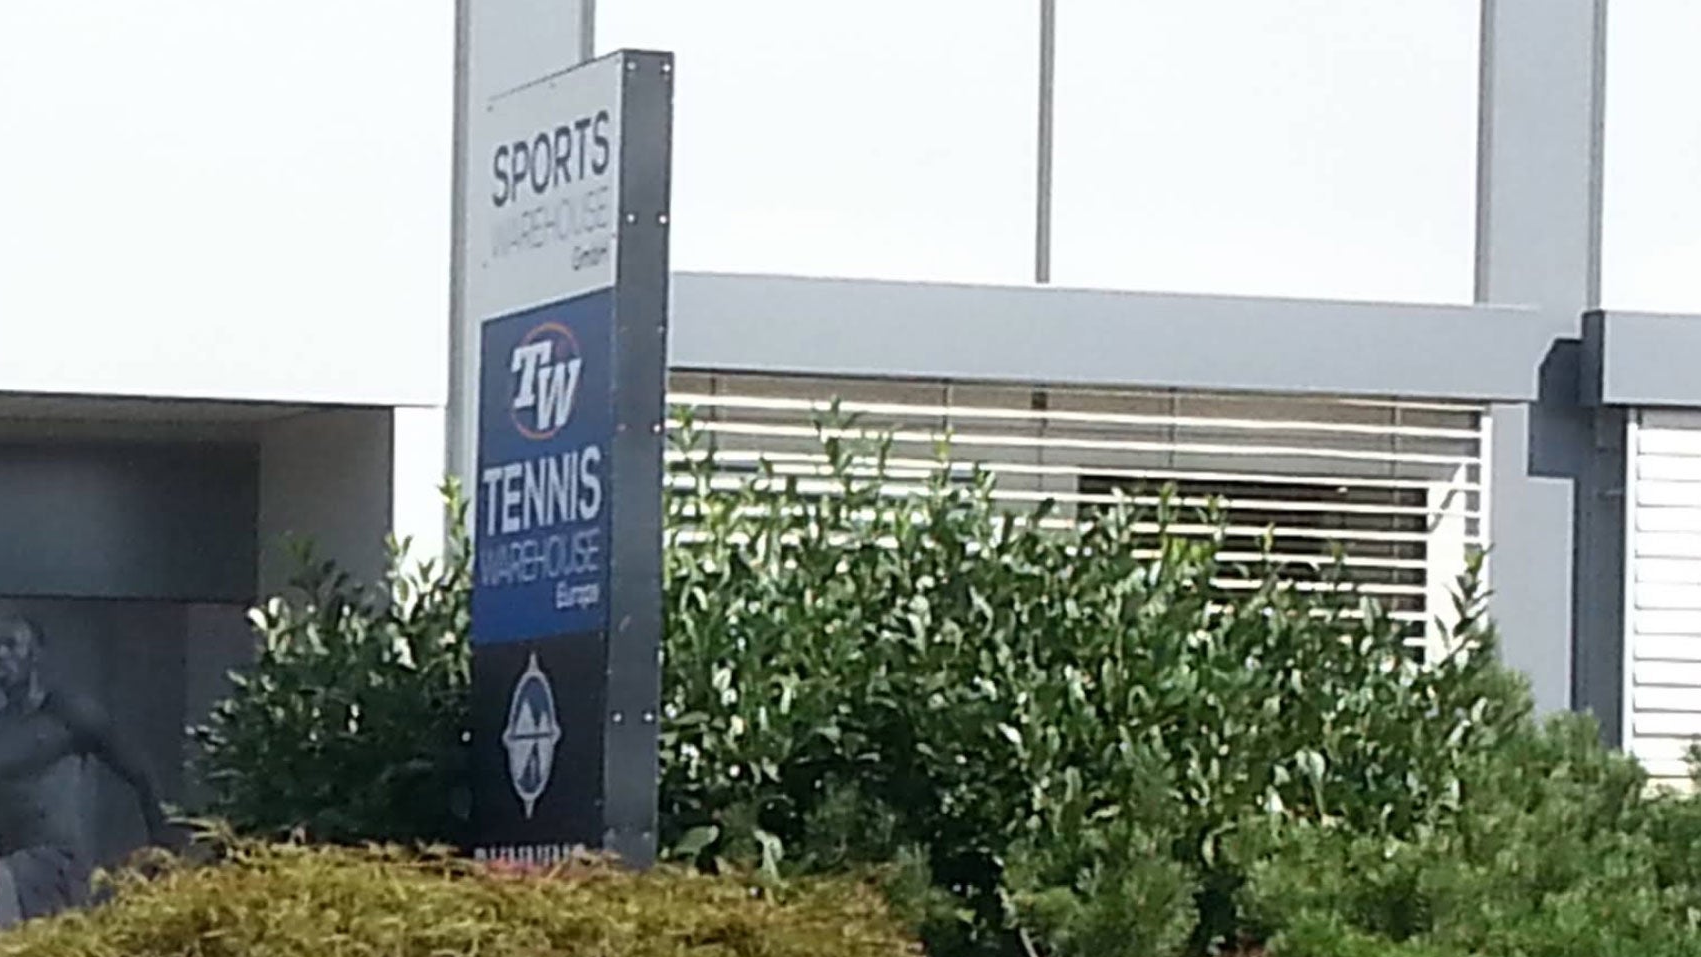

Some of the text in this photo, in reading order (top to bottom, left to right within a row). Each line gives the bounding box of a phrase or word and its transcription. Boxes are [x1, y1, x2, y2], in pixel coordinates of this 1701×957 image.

[491, 109, 611, 208] SPORTS
[510, 339, 582, 431] TW
[481, 444, 602, 537] TENNIS
[479, 528, 601, 588] WAREHOUSE
[555, 581, 601, 611] Europe
